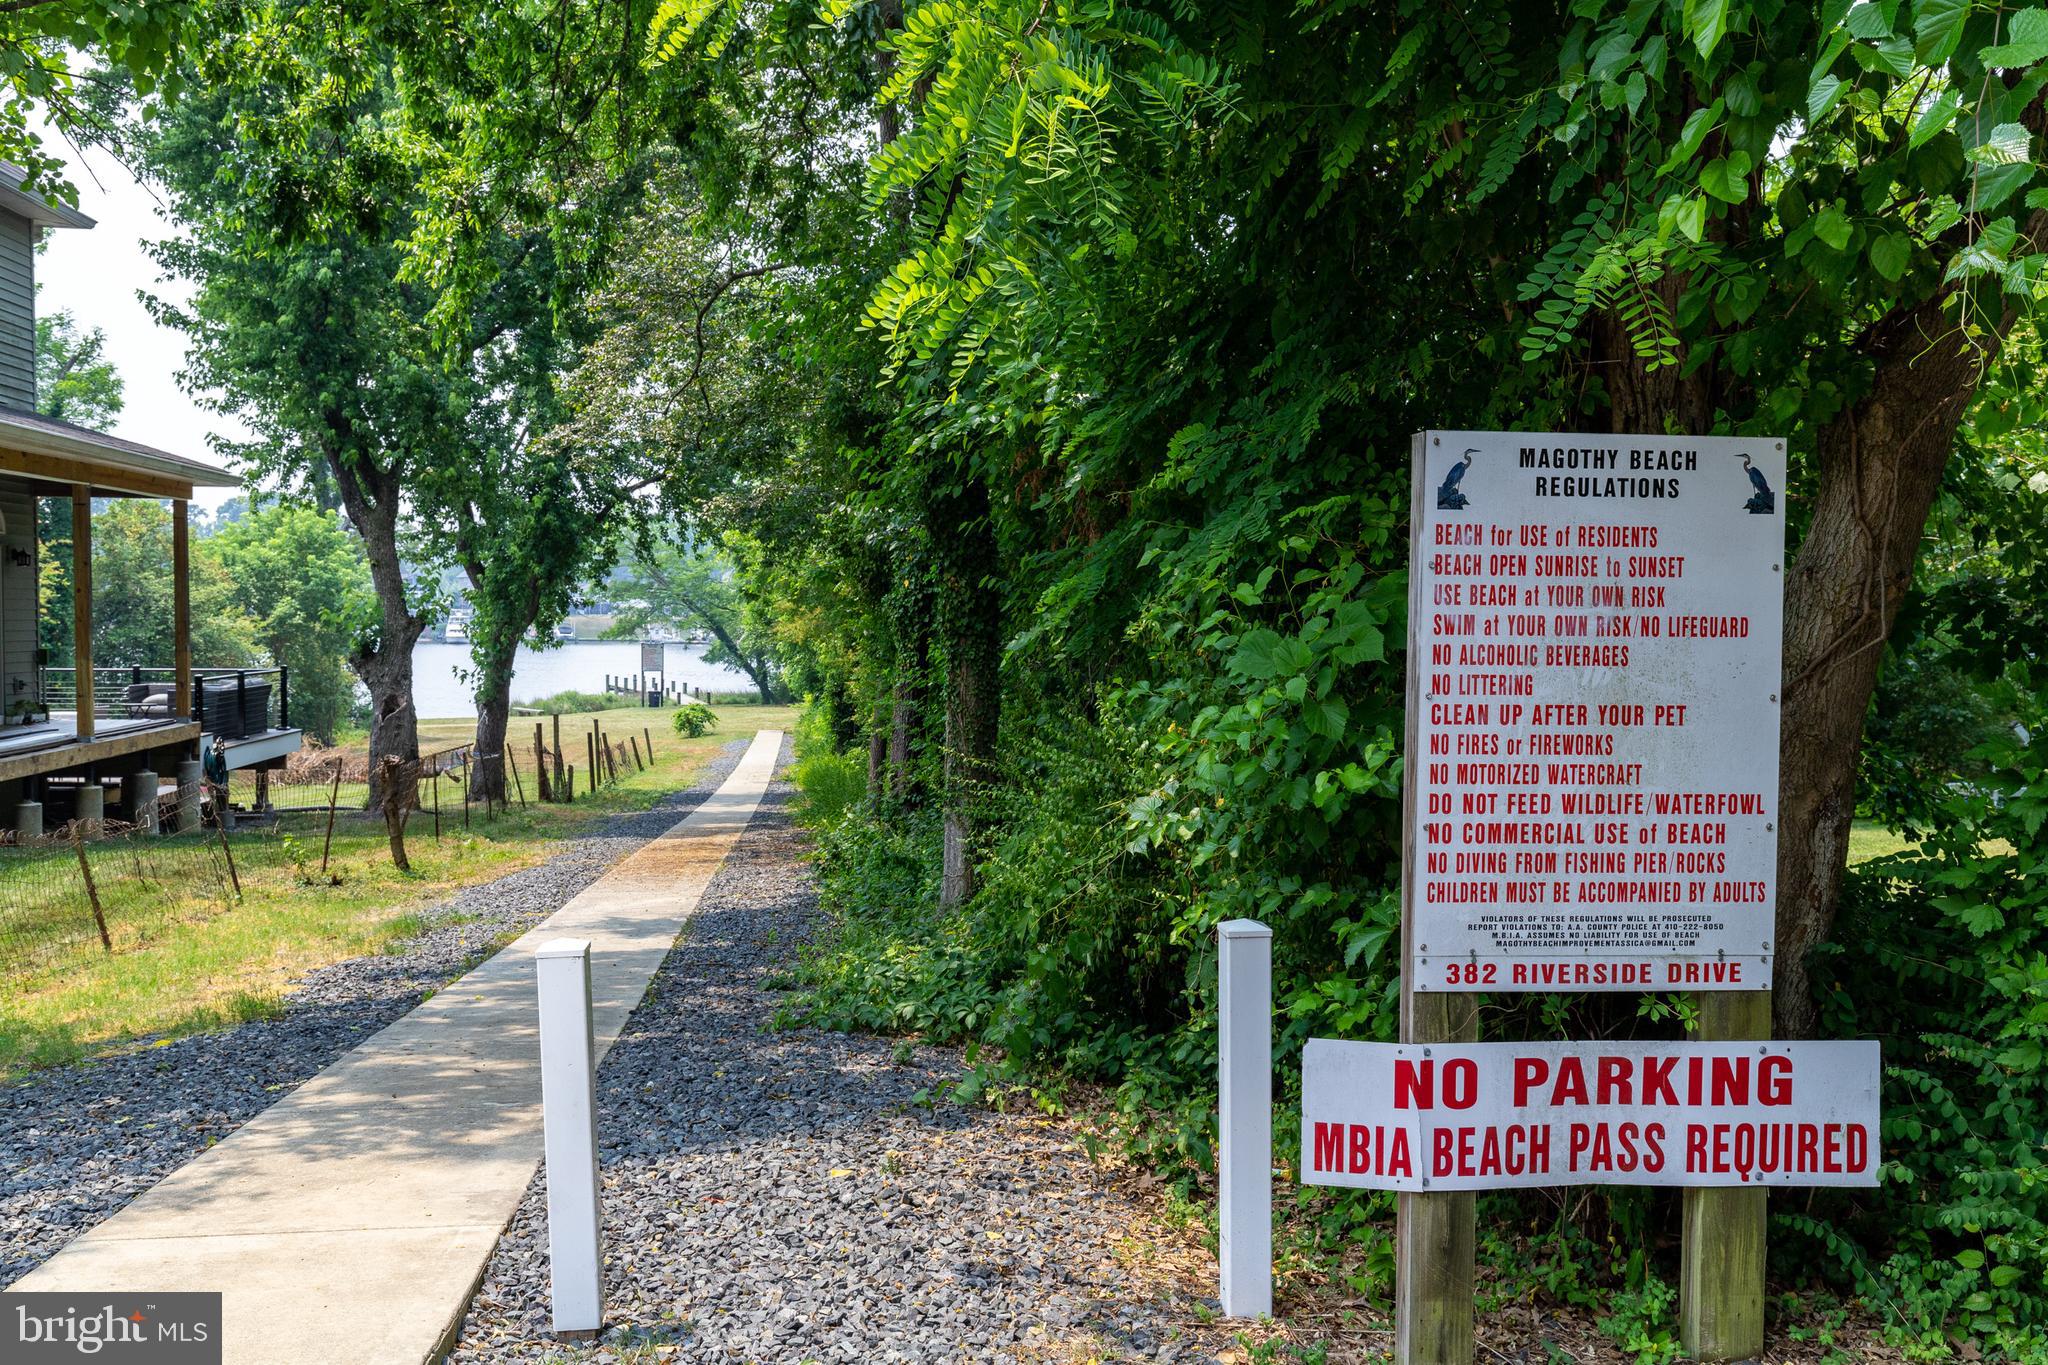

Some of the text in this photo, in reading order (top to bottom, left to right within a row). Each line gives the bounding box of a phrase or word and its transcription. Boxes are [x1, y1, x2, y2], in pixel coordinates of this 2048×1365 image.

[1519, 447, 1697, 471] MAGOTHY BEACH
[1535, 476, 1680, 499] REGULATIONS
[1435, 523, 1658, 549] BEACH for USE of RESIDENTS
[1433, 553, 1685, 579] BEACH OPEN SUNRISE to SUNSET
[1433, 583, 1666, 608] USE BEACH at YOUR OWN RISK
[1433, 613, 1749, 639] SWIM at YOUR OWN RISK/NO LIFEGUARD
[1432, 643, 1629, 668] NO ALCOHOLIC BEVERAGES
[1431, 673, 1533, 696] NO LITTERING
[1431, 703, 1688, 727] CLEAN UP AFTER YOUR PET
[1430, 733, 1614, 756] NO FIRES or FIREWORKS
[1429, 762, 1643, 786] NO MOTORIZED WATERCRAFT
[1428, 792, 1765, 816] DO NOT FEED WILDLIFE/WATERFOWL
[1427, 822, 1726, 845] NO COMMERCIAL USE of BEACH
[1427, 851, 1726, 875] NO DIVING FROM FISHING PIER/ROCKS
[1427, 881, 1766, 904] CHILDREN MUST BE ACCOMPANIED BY ADULTS
[1467, 923, 1724, 931] REPORT VIOLATIONS TO: A.A. COUNTY POLICE AT 410-222-8050
[1481, 915, 1524, 923] VIOLATORS
[1527, 915, 1538, 923] OF
[1540, 915, 1565, 923] THESE
[1569, 915, 1623, 923] REGULATIONS
[1661, 914, 1712, 922] PROSECUTED
[1526, 931, 1566, 939] ASSUMES
[1569, 931, 1580, 939] NO
[1583, 931, 1621, 939] LIABILITY
[1624, 931, 1639, 939] FOR
[1642, 931, 1658, 939] USE
[1661, 931, 1671, 939] OF
[1674, 931, 1700, 939] BEACH
[1445, 962, 1742, 985] 382 RIVERSIDE DRIVE
[1393, 1055, 1794, 1110] NO PARKING
[1313, 1121, 1869, 1183] MBIA BEACH PASS REQUIRED
